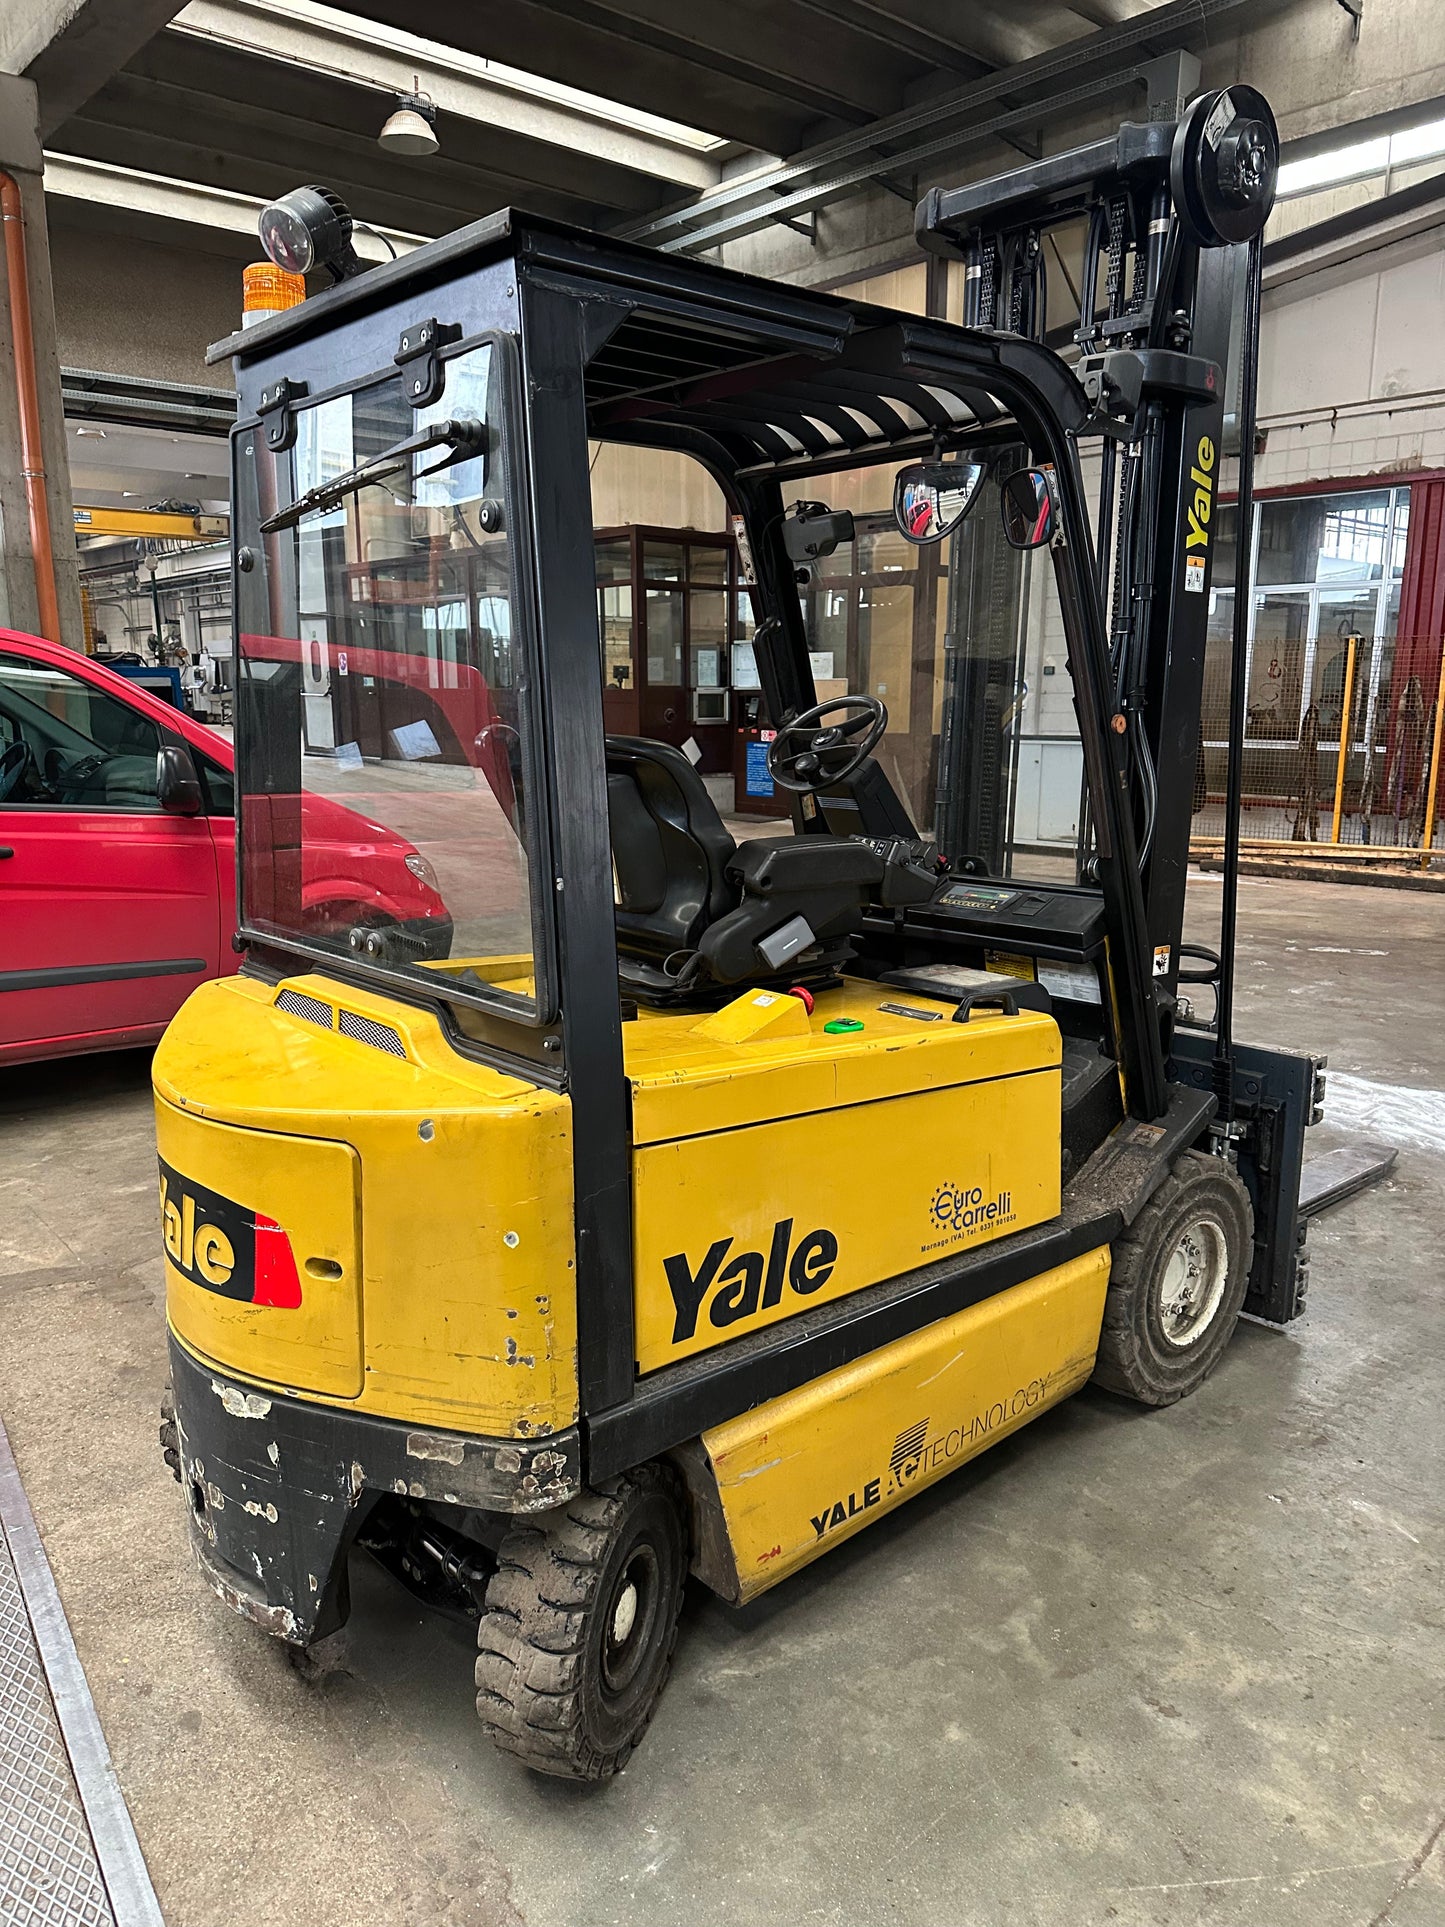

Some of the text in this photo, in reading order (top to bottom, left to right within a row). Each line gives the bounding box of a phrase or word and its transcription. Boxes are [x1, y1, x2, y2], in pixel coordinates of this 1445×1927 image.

[1186, 436, 1215, 549] Yale
[663, 1217, 838, 1344] Yale
[921, 1239, 949, 1253] Mornago
[950, 1232, 965, 1244] (VA)
[810, 1477, 881, 1541] YALE
[920, 1377, 1050, 1473] TECHNOLOGY
